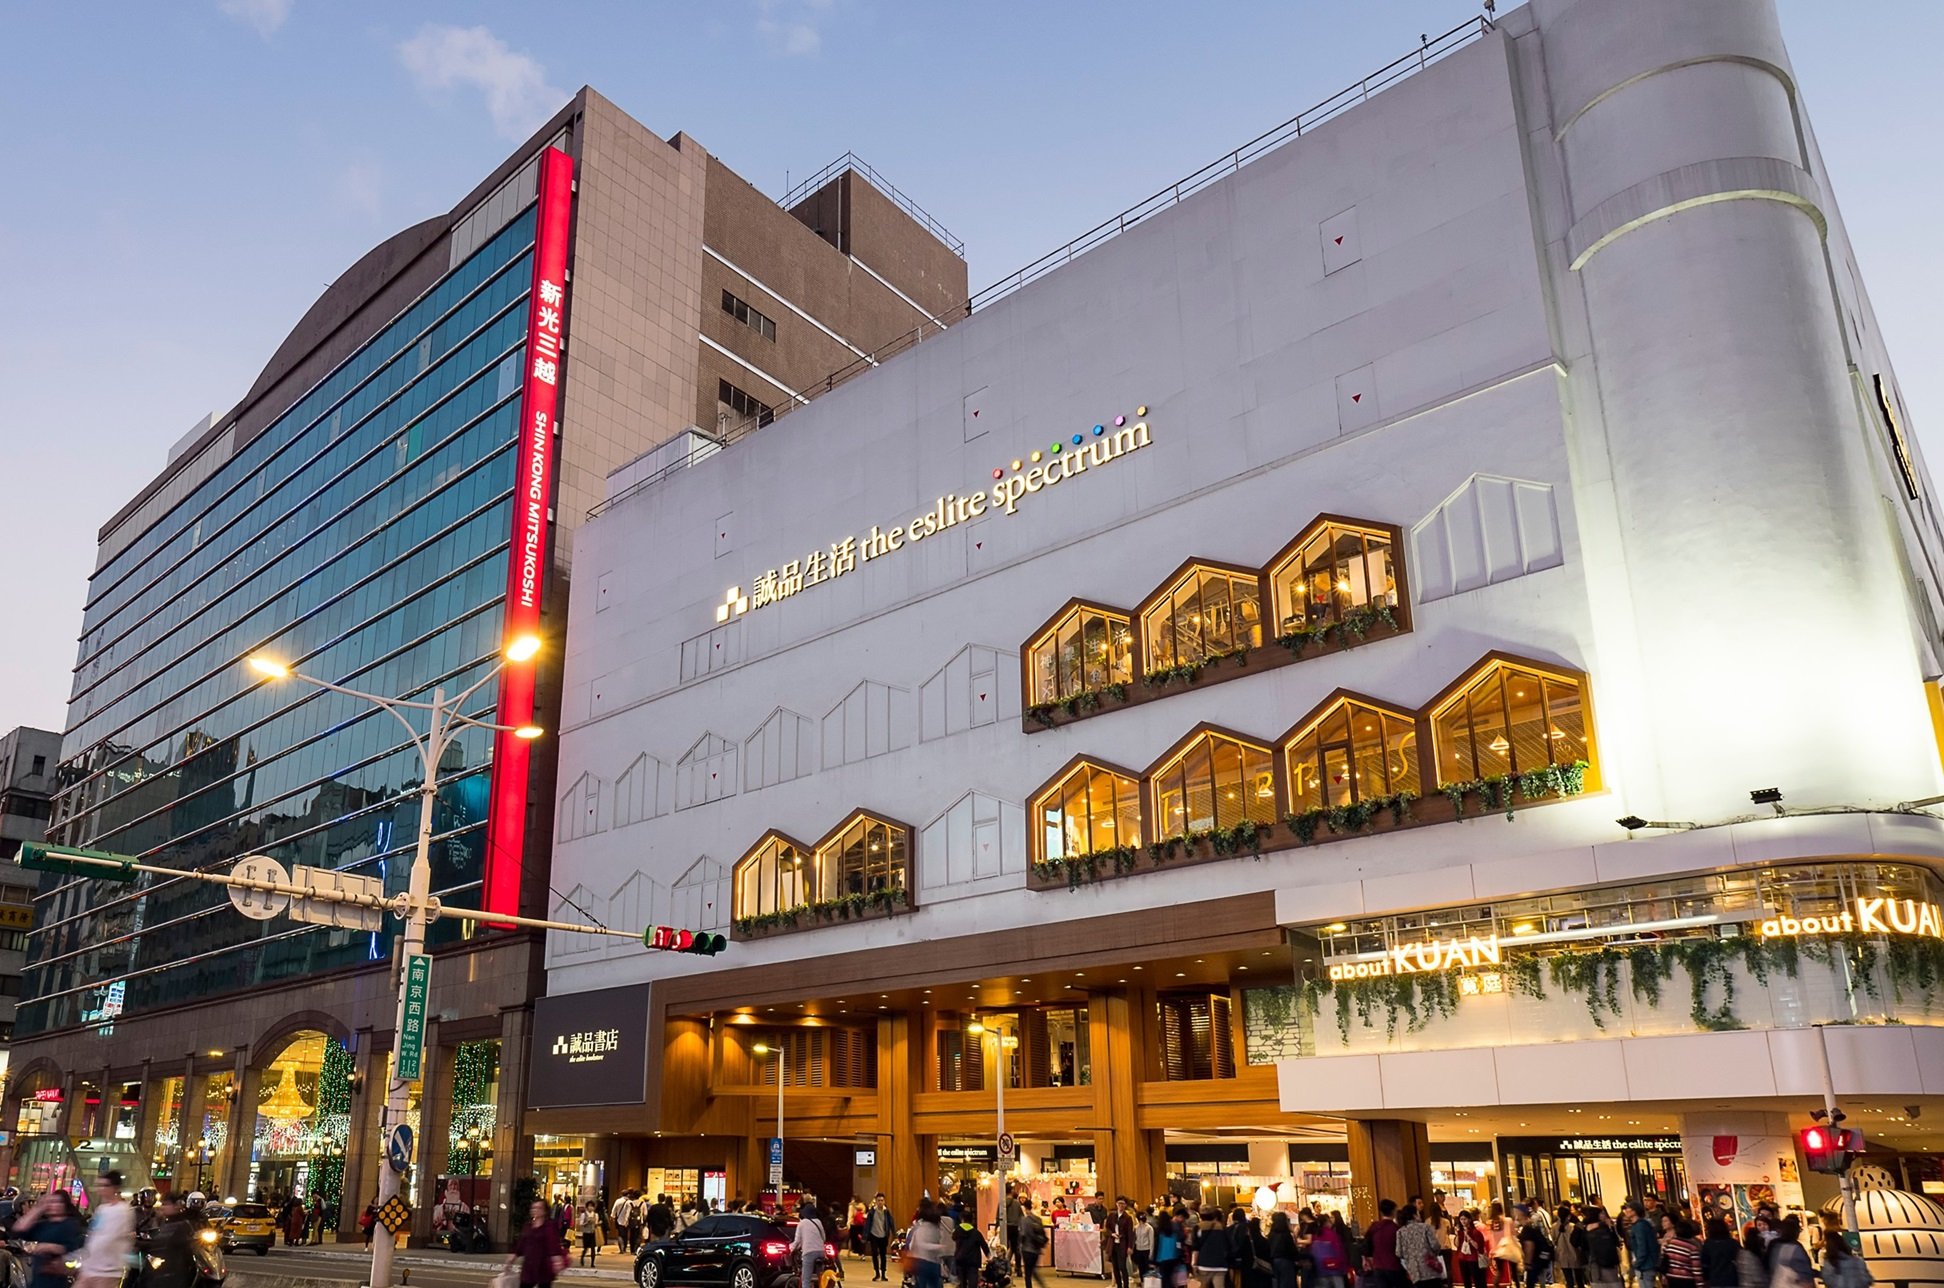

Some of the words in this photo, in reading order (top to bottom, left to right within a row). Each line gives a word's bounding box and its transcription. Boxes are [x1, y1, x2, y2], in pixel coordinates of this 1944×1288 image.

[532, 279, 562, 386] 新光三越
[532, 411, 547, 452] SHIN
[528, 453, 544, 500] KONG
[752, 535, 857, 609] 誠品生活
[860, 525, 904, 561] the
[908, 490, 987, 541] eslite
[992, 420, 1153, 515] spectrum
[521, 501, 541, 607] MITSUKOSHI
[1762, 910, 1853, 937] about
[1329, 959, 1392, 980] about
[1394, 935, 1501, 973] KUAN
[407, 968, 425, 1032] 南京西路
[402, 1042, 416, 1050] Jing
[570, 1029, 618, 1053] 誠品書店
[78, 1139, 95, 1150] 2
[1573, 1139, 1611, 1150] 誠品生活
[1612, 1139, 1628, 1149] the
[1629, 1139, 1653, 1149] eslite
